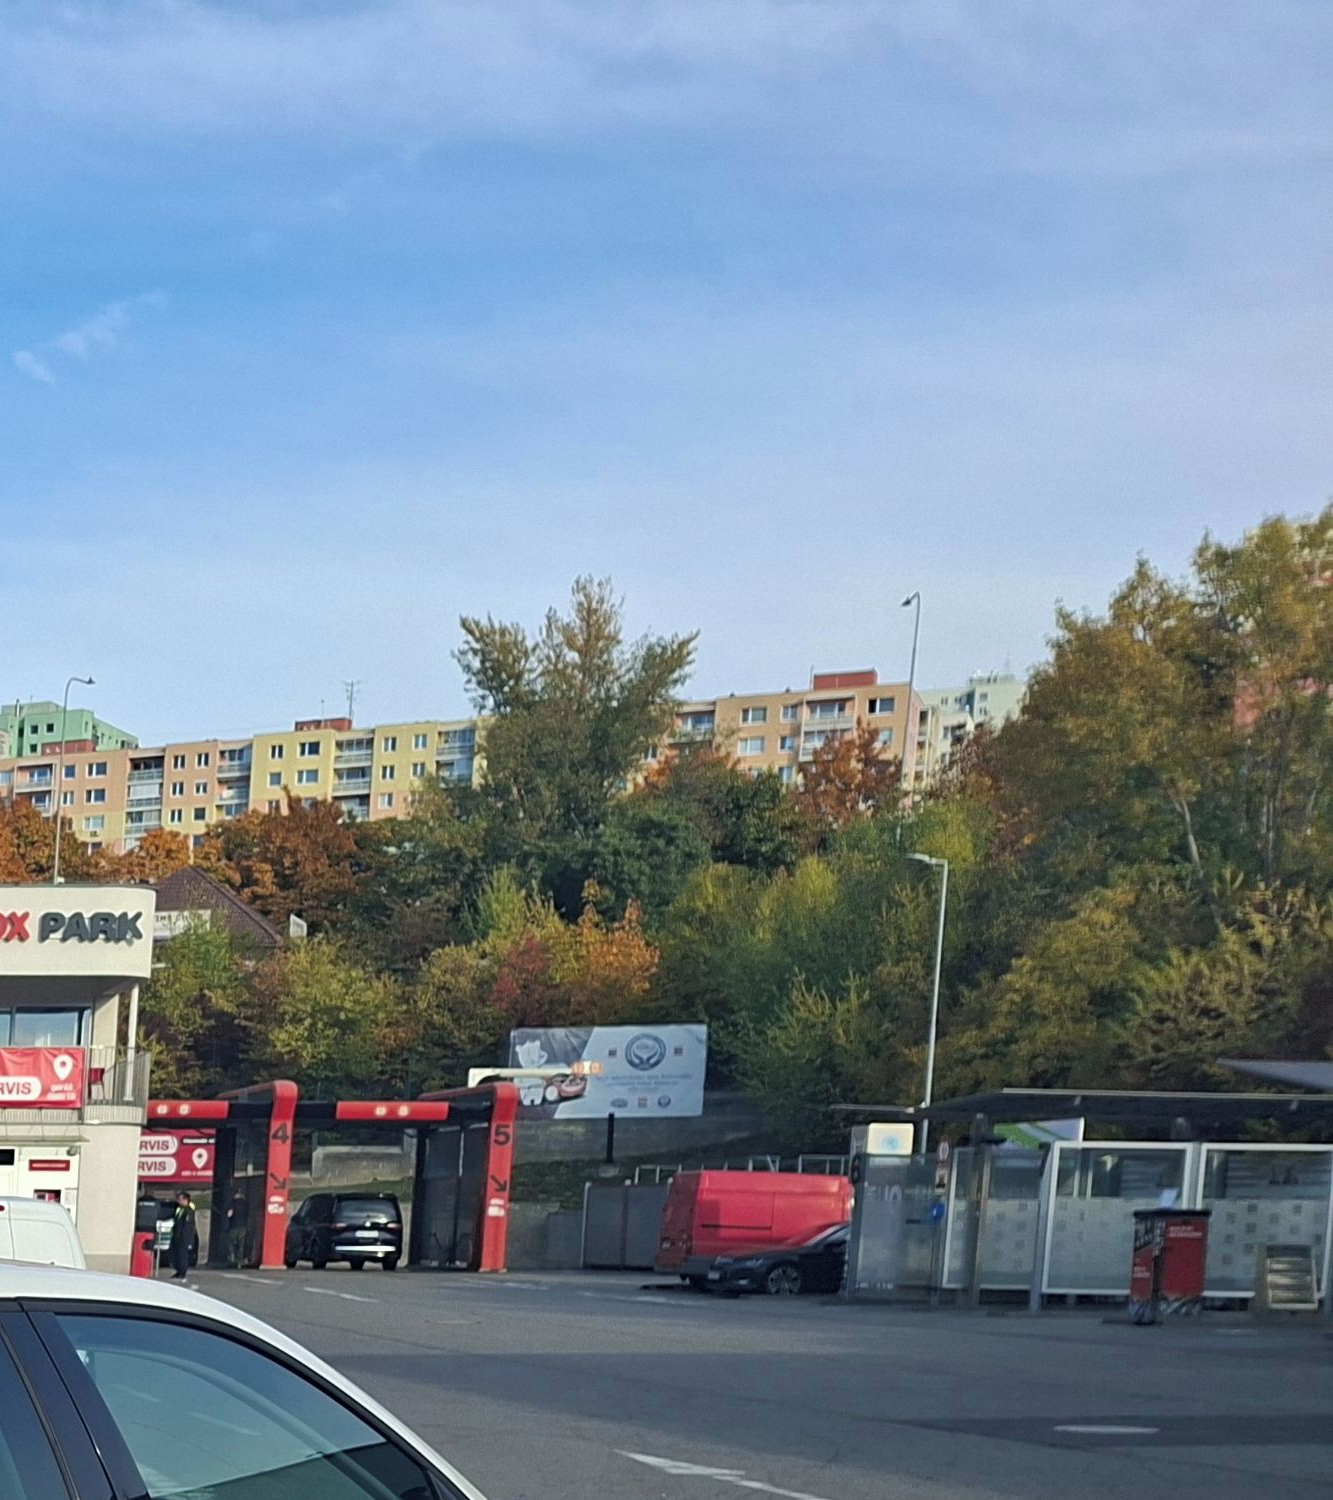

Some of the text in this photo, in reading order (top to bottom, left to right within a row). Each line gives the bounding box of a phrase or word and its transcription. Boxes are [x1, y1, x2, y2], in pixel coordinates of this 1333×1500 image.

[38, 911, 144, 943] PARK
[271, 1122, 289, 1144] 4
[493, 1124, 511, 1146] 5
